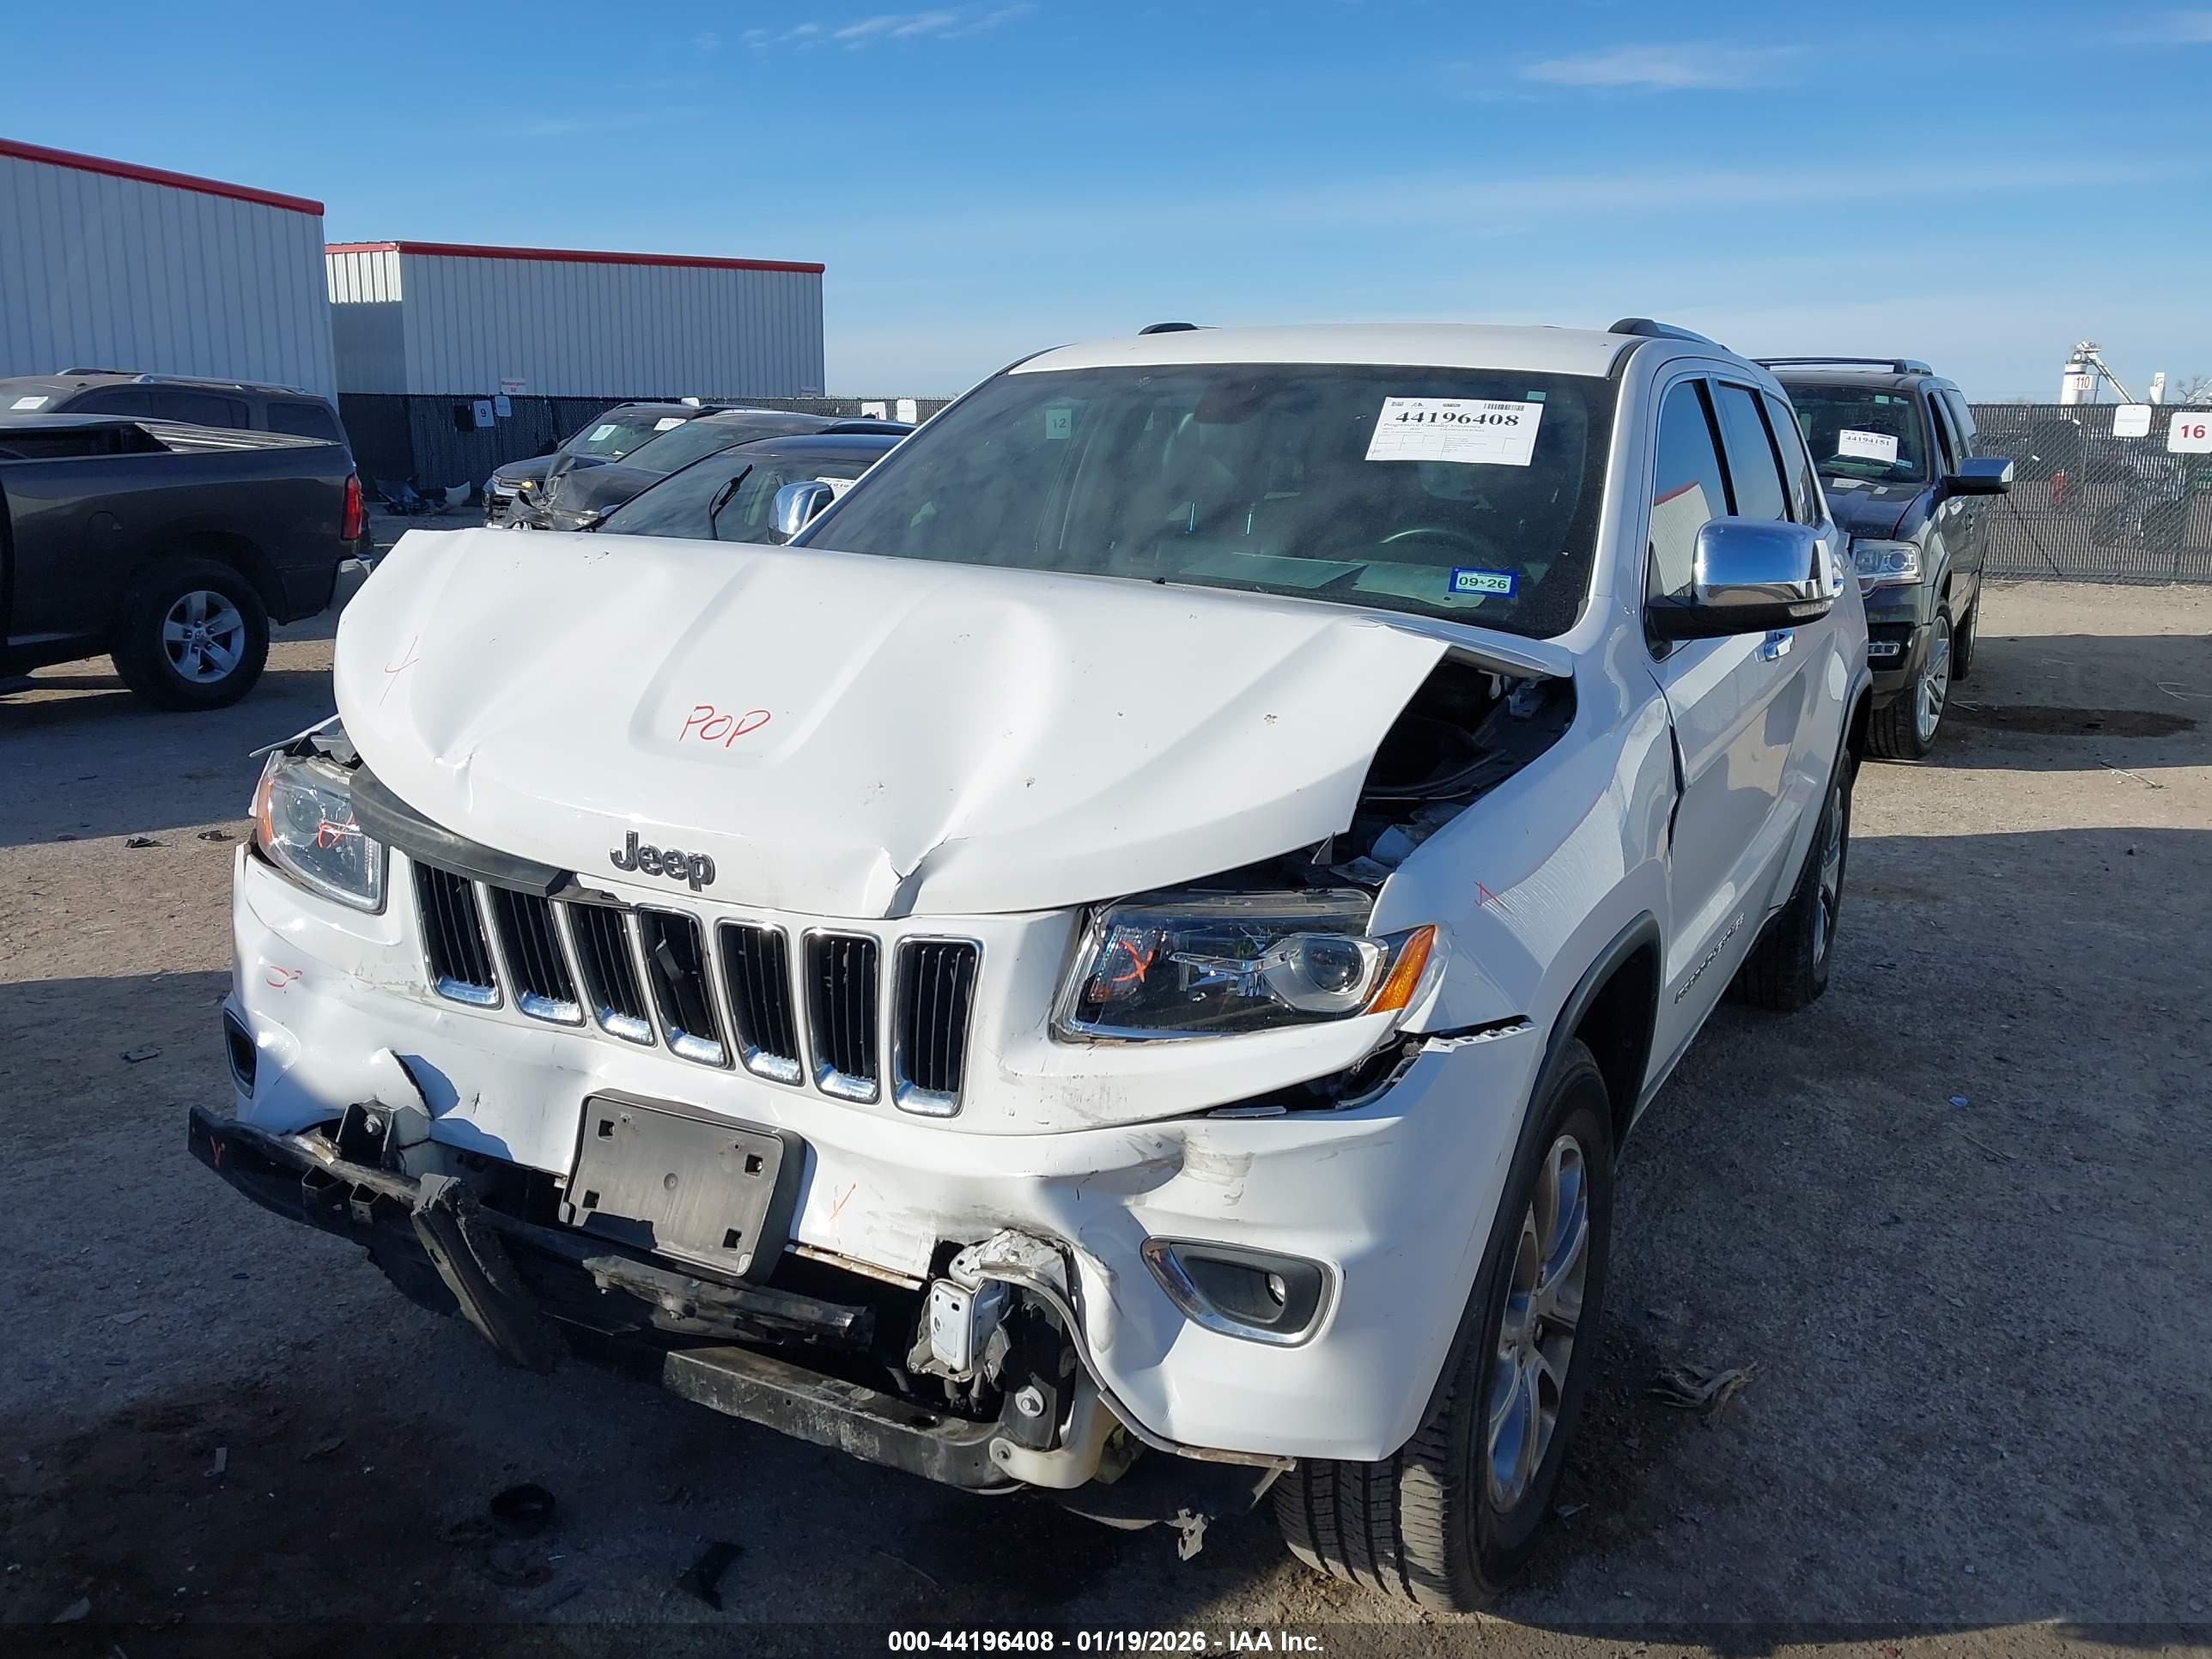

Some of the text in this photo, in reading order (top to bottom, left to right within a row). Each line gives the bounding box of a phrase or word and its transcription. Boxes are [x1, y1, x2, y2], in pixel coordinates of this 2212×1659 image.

[2075, 376, 2090, 388] 110
[480, 409, 487, 418] 9
[1395, 411, 1520, 427] 44196408
[1052, 417, 1066, 428] 12
[2180, 424, 2206, 439] 16
[1459, 576, 1507, 589] 09 26
[679, 705, 770, 748] POP
[610, 830, 715, 892] Jeep
